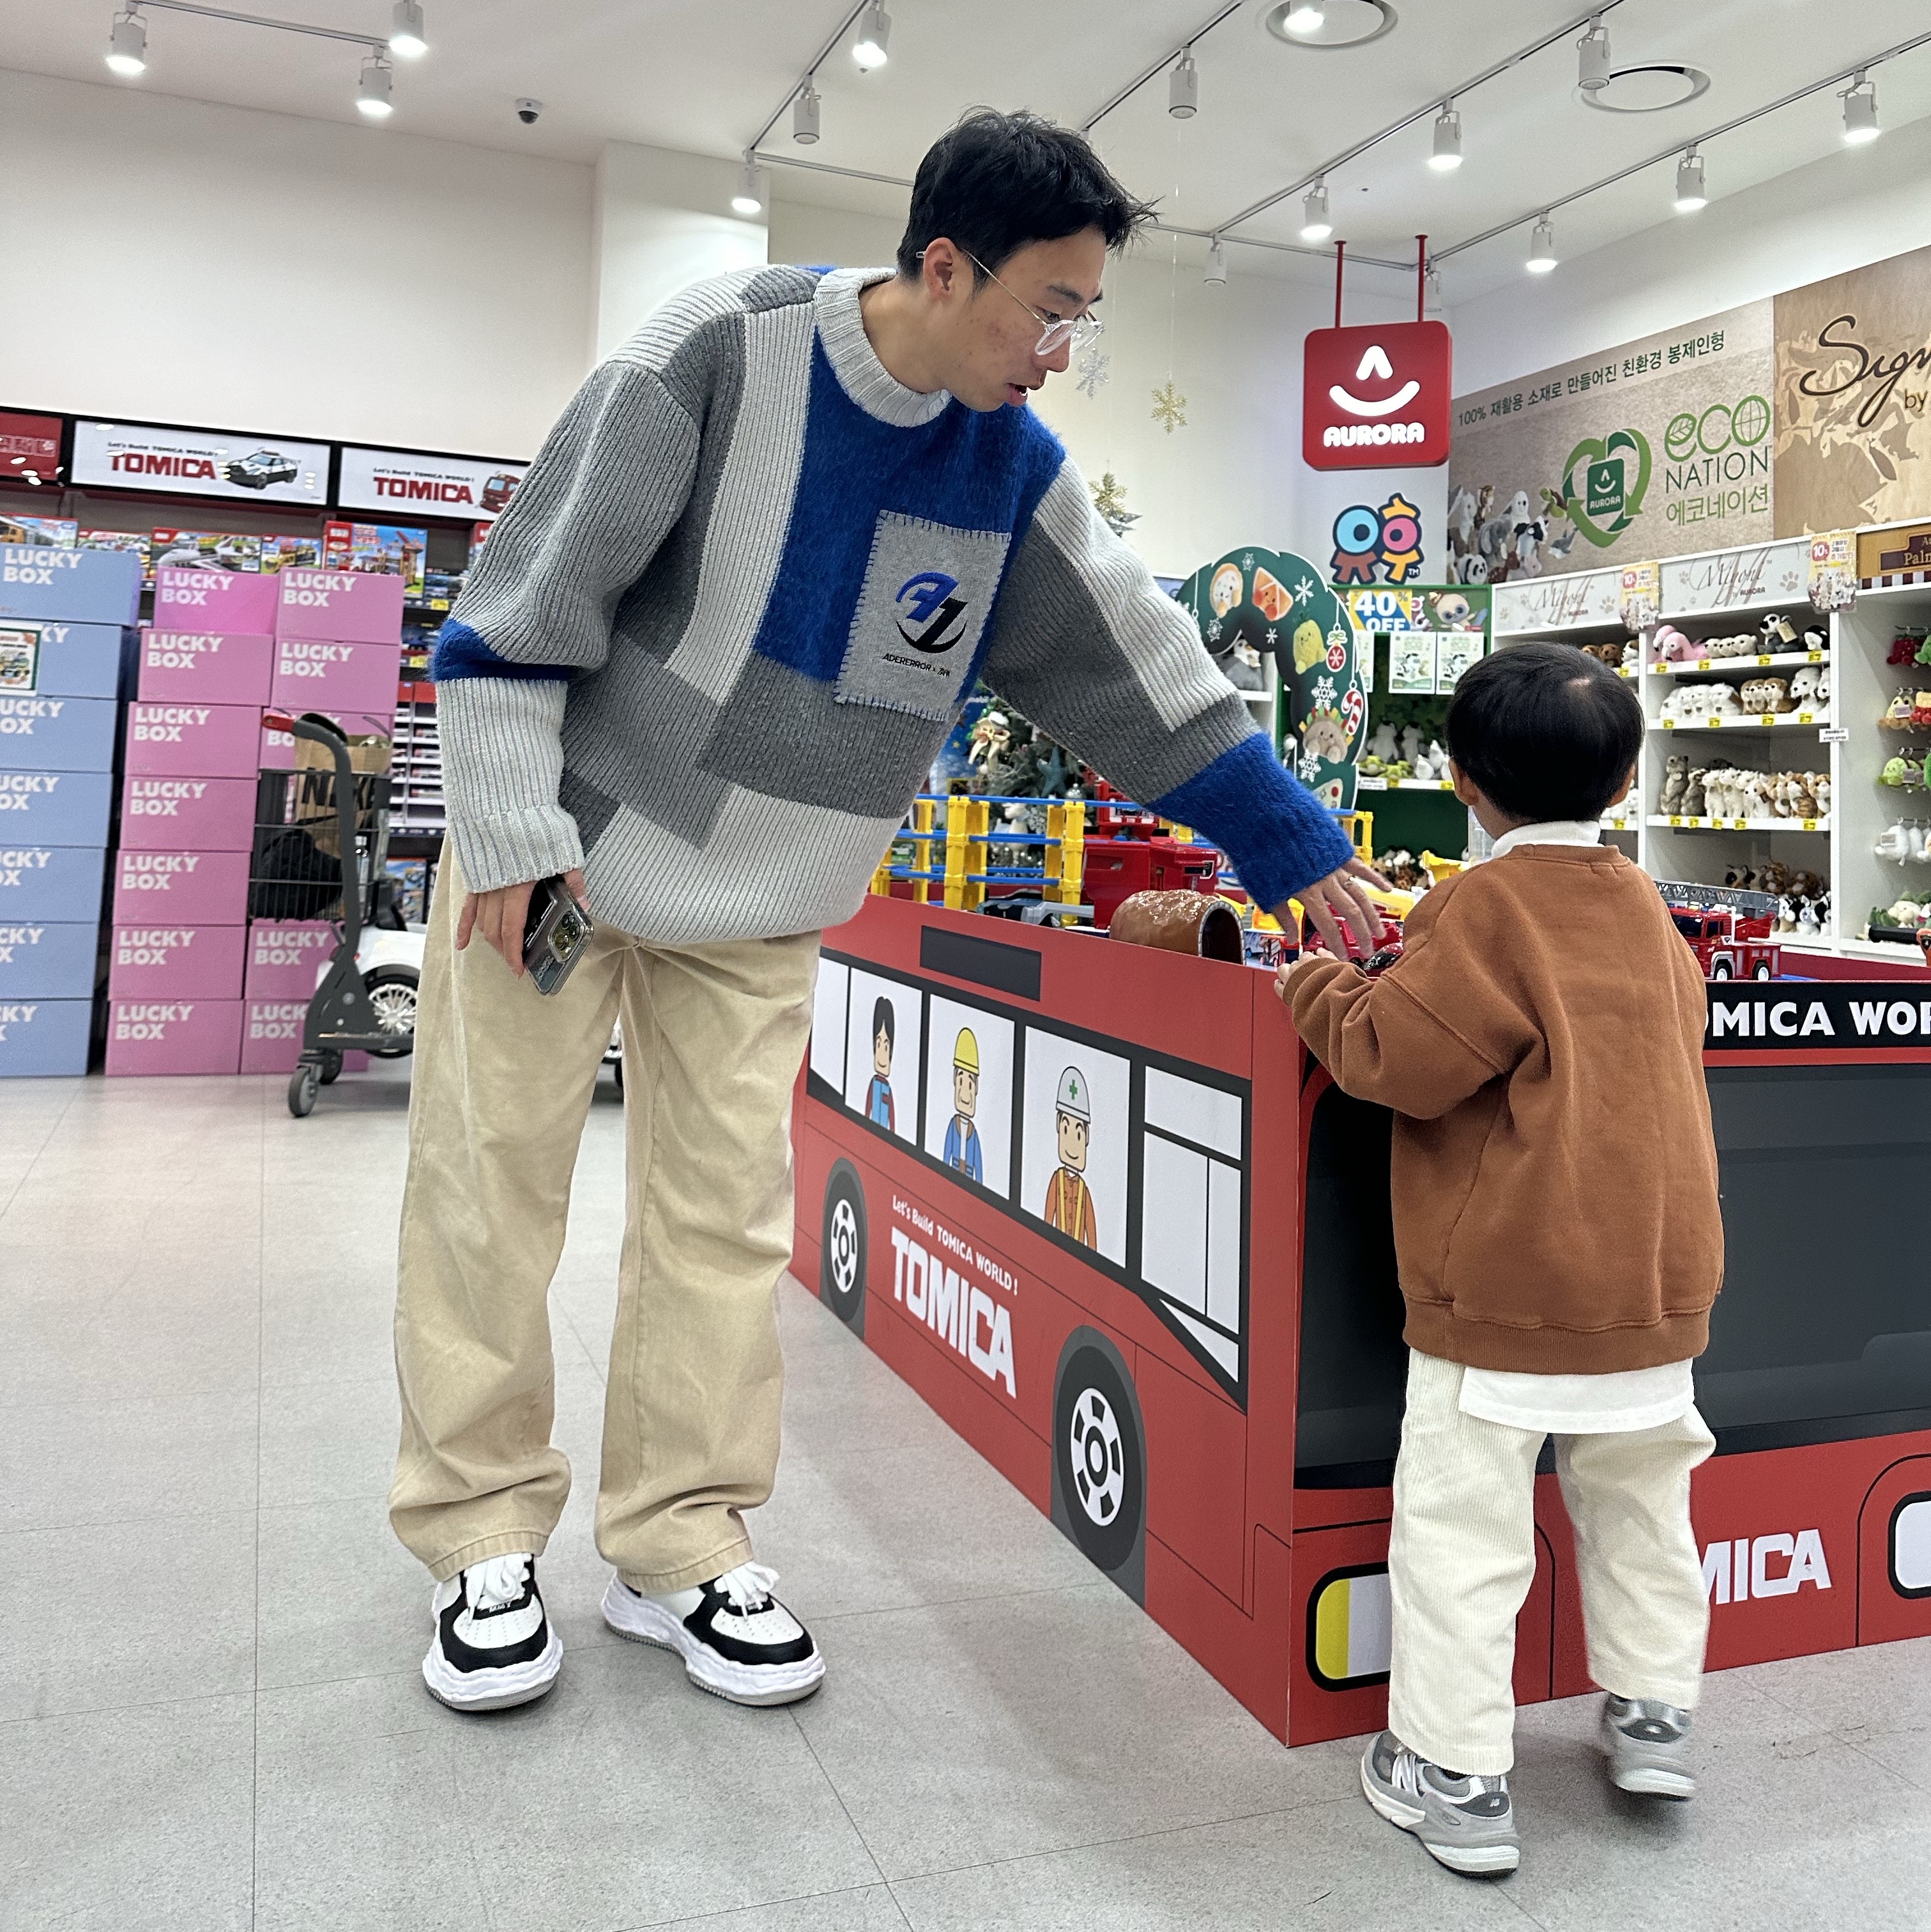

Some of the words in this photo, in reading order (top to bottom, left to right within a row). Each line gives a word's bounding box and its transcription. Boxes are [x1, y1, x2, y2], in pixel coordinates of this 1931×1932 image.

[1458, 406, 1486, 426] 100%
[1490, 393, 1524, 417] 재활용
[1527, 383, 1562, 406] 소재로
[1568, 363, 1617, 395] 만들어진
[1622, 349, 1662, 378] 친환경
[1668, 330, 1725, 365] 봉제인형
[1905, 388, 1928, 413] by
[1324, 422, 1424, 447] AURORA
[109, 452, 217, 480] TOMICA
[1666, 445, 1767, 493] NATION
[373, 477, 473, 504] TOMICA
[1590, 495, 1621, 509] AURORA
[1667, 483, 1768, 526] 에코네이션
[4, 548, 82, 569] LUCKY
[3, 567, 54, 585] BOX
[162, 572, 234, 591] LUCKY
[285, 572, 356, 592] LUCKY
[160, 588, 208, 606] BOX
[283, 590, 329, 607] BOX
[1354, 590, 1397, 617] 40
[148, 634, 224, 652] LUCKY
[146, 652, 195, 669] BOX
[281, 643, 353, 662] LUCKY
[279, 660, 326, 677] BOX
[882, 653, 931, 671] ADERERROR
[0, 699, 65, 718] UCKY
[135, 707, 210, 725] LUCKY
[0, 717, 34, 735] OX
[133, 725, 183, 742] BOX
[267, 732, 294, 747] BO
[0, 775, 60, 793] UCKY
[131, 781, 207, 799] LUCKY
[0, 793, 29, 811] OX
[129, 799, 179, 816] BOX
[0, 851, 52, 869] CKY
[123, 855, 199, 873] LUCKY
[121, 873, 171, 890] BOX
[0, 928, 45, 945] CKY
[119, 930, 195, 947] LUCKY
[256, 931, 330, 947] LUCKY
[118, 949, 167, 965] BOX
[254, 949, 301, 965] BOX
[117, 1004, 194, 1022] LUCKY
[251, 1004, 307, 1022] LUCK
[1706, 1001, 1836, 1037] MICA
[116, 1023, 165, 1040] BOX
[250, 1023, 297, 1039] BOX
[892, 1194, 911, 1220] Let's
[912, 1208, 934, 1236] Build
[937, 1225, 973, 1265] TOMICA
[976, 1251, 1012, 1291] WORLD
[891, 1225, 1017, 1400] TOMICA
[1702, 1528, 1832, 1605] MICA
